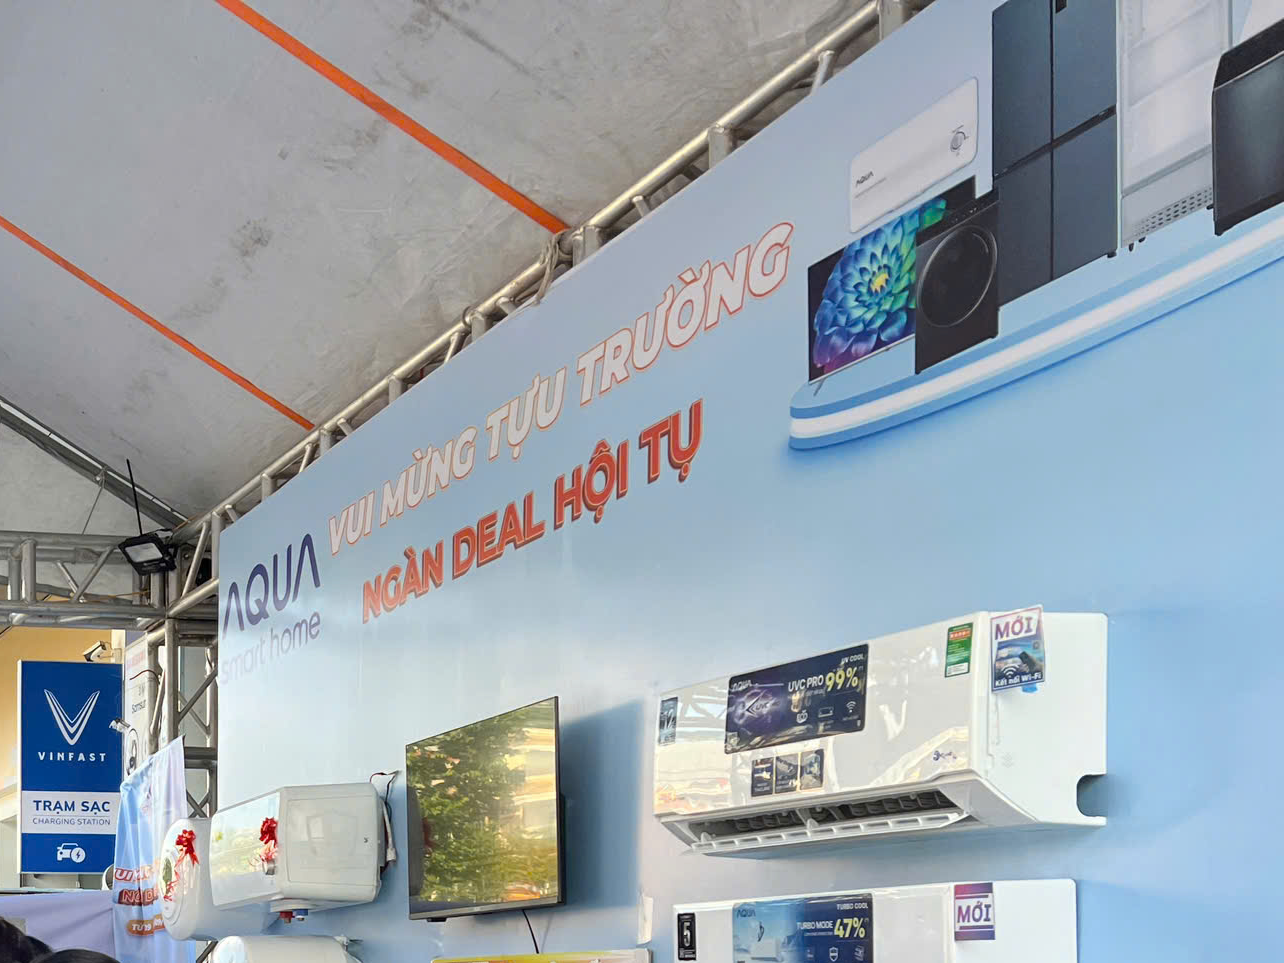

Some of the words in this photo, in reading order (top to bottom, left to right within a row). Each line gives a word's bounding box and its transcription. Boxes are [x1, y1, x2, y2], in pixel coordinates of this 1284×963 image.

[327, 491, 376, 556] VUI
[380, 426, 478, 526] MỪNG
[485, 367, 567, 459] TỰU
[576, 222, 795, 407] TRƯỜNG
[362, 545, 444, 625] NGÀN
[451, 490, 546, 579] DEAL
[554, 434, 629, 523] HỘI
[639, 398, 704, 484] TỤ
[222, 533, 321, 640] AQUA
[994, 614, 1034, 641] MỚI
[220, 636, 266, 685] smart
[270, 610, 321, 660] home
[788, 677, 806, 692] UVC
[806, 675, 824, 688] PRO
[825, 667, 859, 691] 99%
[38, 751, 107, 762] VINFAST
[33, 800, 75, 813] TRẠM
[81, 800, 111, 815] SẠC
[32, 817, 75, 826] CHARGING
[78, 817, 111, 826] STATION
[736, 908, 756, 918] AQUA
[957, 898, 990, 924] MỚI
[683, 921, 691, 947] 5
[816, 920, 834, 929] MODE
[834, 917, 866, 938] 47%
